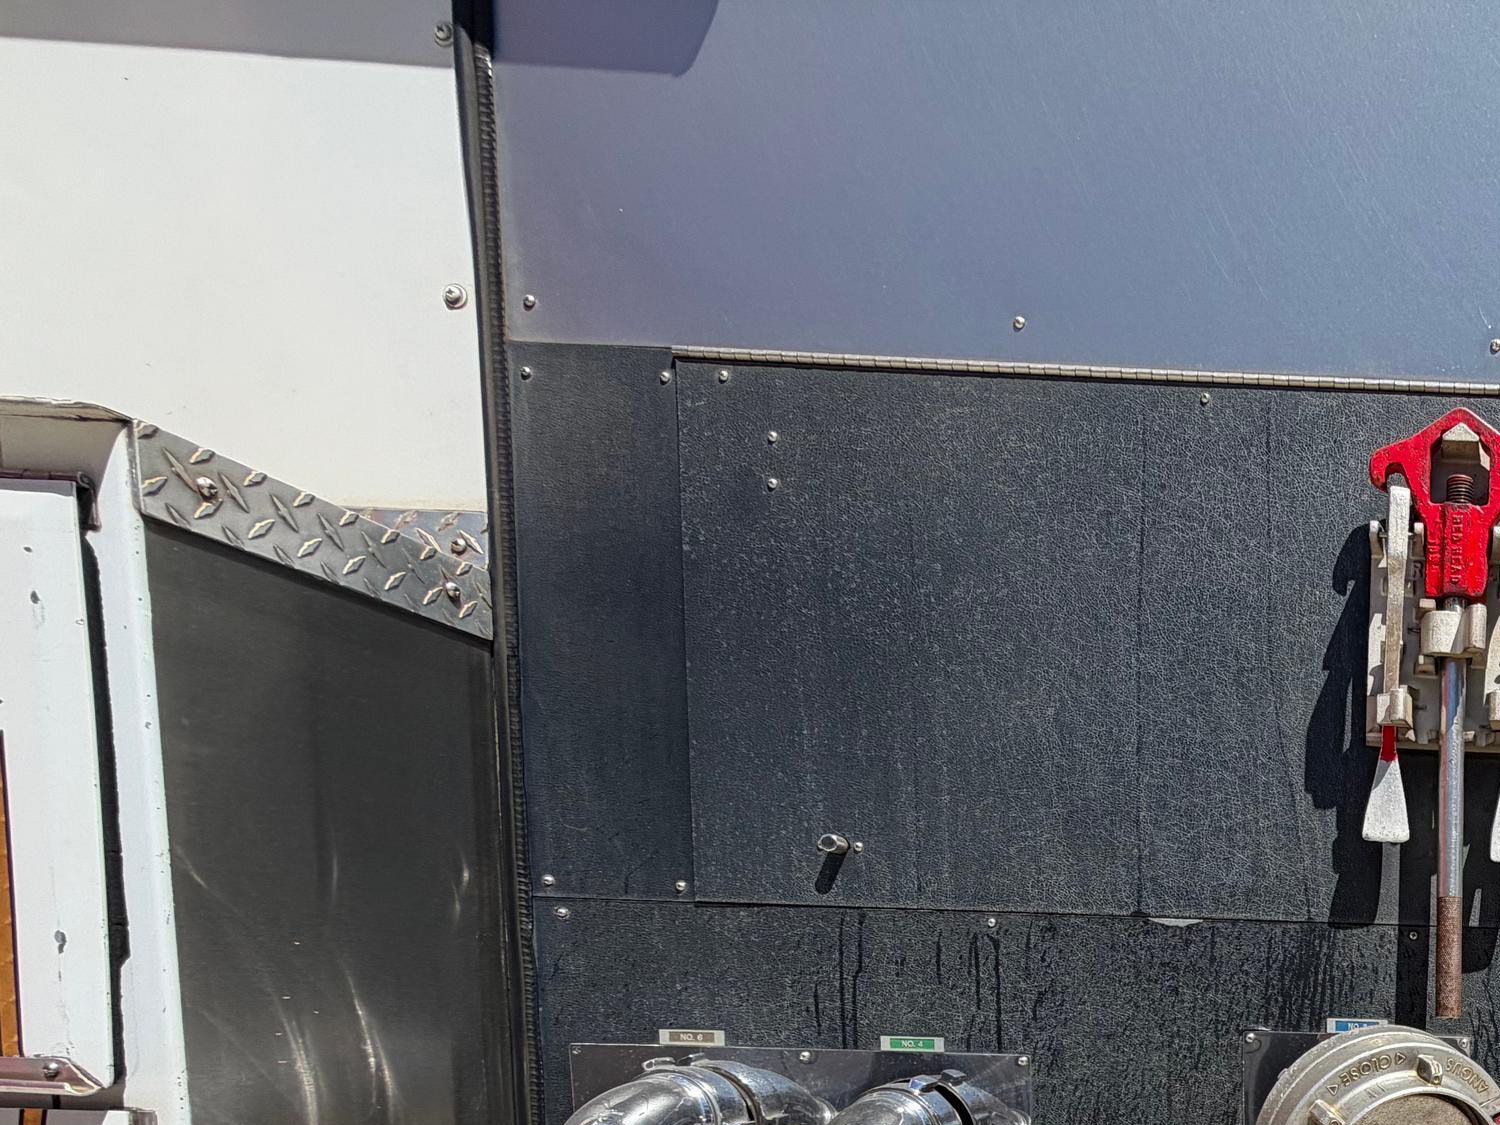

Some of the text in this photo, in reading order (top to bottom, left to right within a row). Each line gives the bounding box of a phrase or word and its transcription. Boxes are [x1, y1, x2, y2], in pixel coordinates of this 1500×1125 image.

[680, 1033, 704, 1041] NO. 6
[901, 1040, 916, 1048] NO.
[1339, 1054, 1392, 1088] CLOSE
[1445, 1057, 1489, 1094] ANGUS
